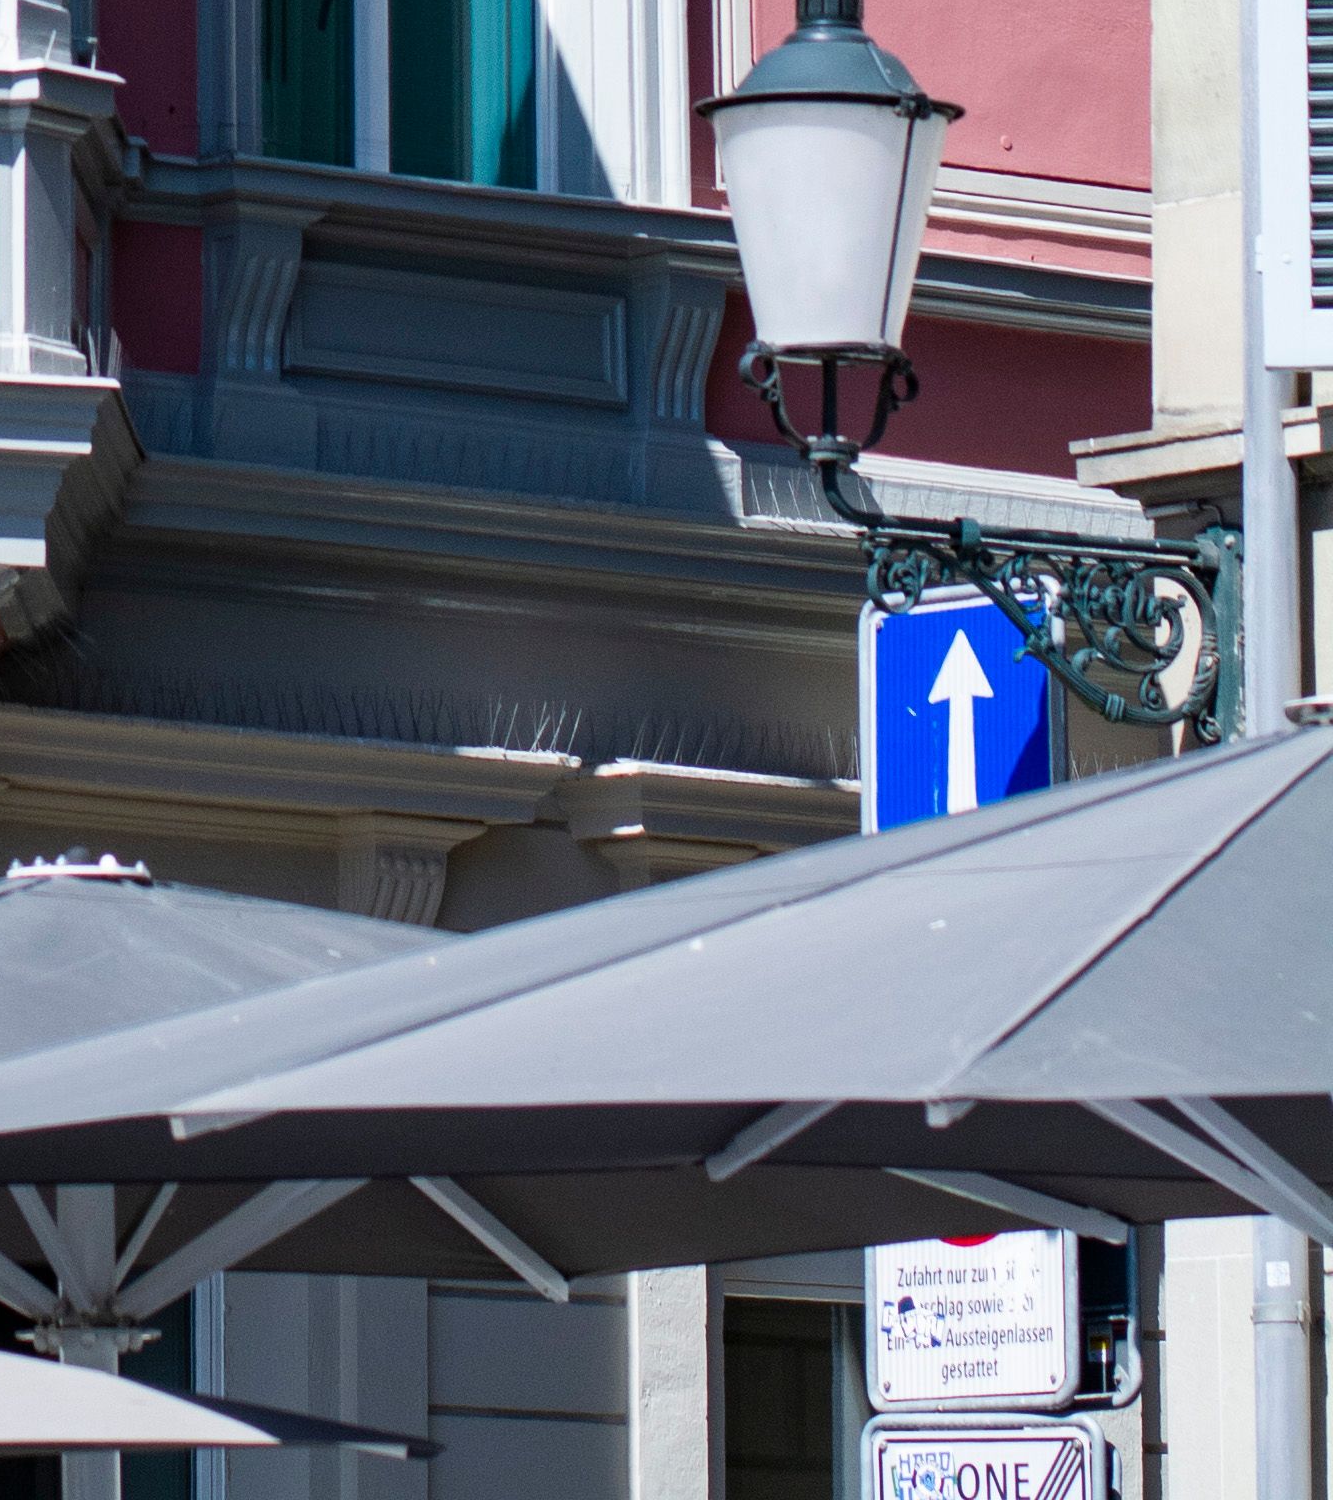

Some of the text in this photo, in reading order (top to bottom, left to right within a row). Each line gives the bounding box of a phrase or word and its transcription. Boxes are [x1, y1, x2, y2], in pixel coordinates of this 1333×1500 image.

[897, 1265, 942, 1288] Zufahrt
[946, 1268, 968, 1285] nur
[967, 1292, 1005, 1315] sowie
[945, 1322, 1054, 1350] Aussteigenlassen
[941, 1357, 999, 1385] gestattet
[954, 1462, 1031, 1500] ONE
